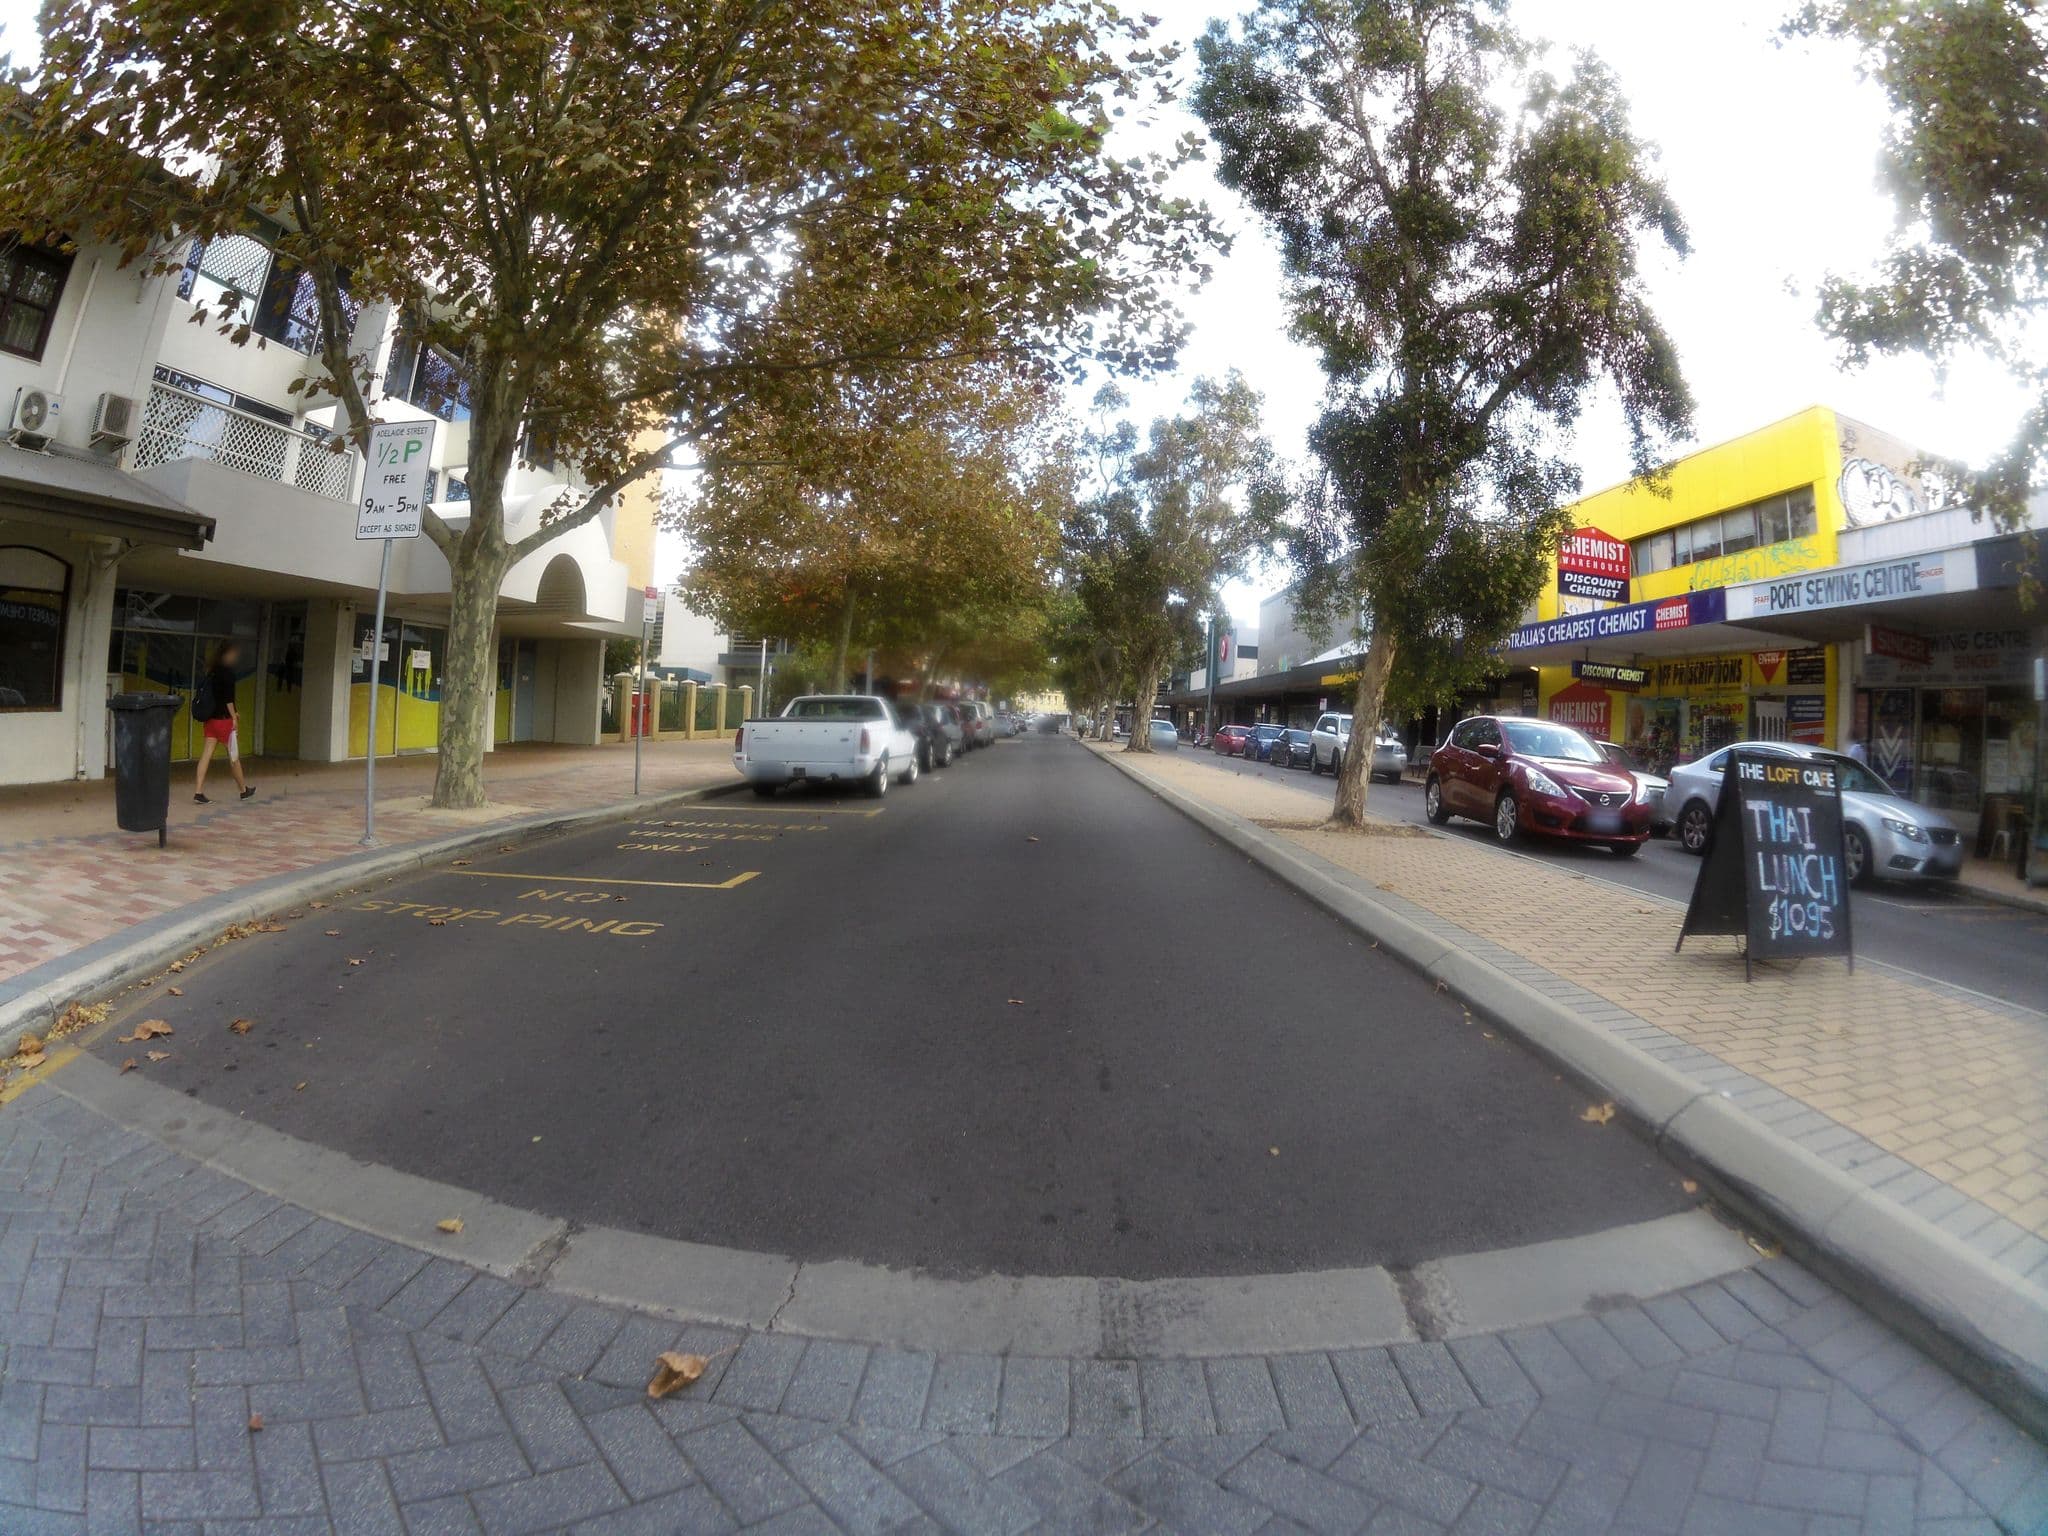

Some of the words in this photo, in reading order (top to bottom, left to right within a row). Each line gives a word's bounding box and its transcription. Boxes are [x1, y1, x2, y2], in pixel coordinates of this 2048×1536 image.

[376, 429, 405, 438] ADELAIDE
[406, 426, 429, 436] STREET
[383, 474, 407, 484] FREE
[364, 498, 385, 514] 9AM
[396, 496, 419, 513] 5PM
[359, 525, 382, 534] EXCEPT
[383, 524, 393, 533] AS
[394, 523, 417, 533] SIGNED
[1562, 556, 1627, 574] WAREHOUSE
[1918, 567, 1945, 579] SINGER
[1564, 573, 1625, 589] DISCOUNT
[1770, 581, 1801, 611] PORT
[1805, 572, 1861, 605] SEWING
[1863, 561, 1922, 595] CENTRE
[1569, 584, 1619, 599] CHEMIST
[1655, 604, 1688, 621] CHEMIST
[1547, 618, 1596, 643] CHEAPEST
[1598, 609, 1647, 635] CHEMIST
[1581, 664, 1617, 679] DISCOUNT
[1617, 668, 1645, 682] CHEMIST
[1552, 701, 1607, 724] CHEMIST
[1738, 762, 1765, 781] THE
[1767, 765, 1800, 785] LOFT
[1803, 770, 1836, 788] CAFE
[1746, 800, 1816, 850] THAI
[628, 830, 774, 841] VEHICLES
[616, 842, 711, 853] ONLY
[1757, 851, 1838, 907] LUNCH
[515, 888, 610, 903] NO
